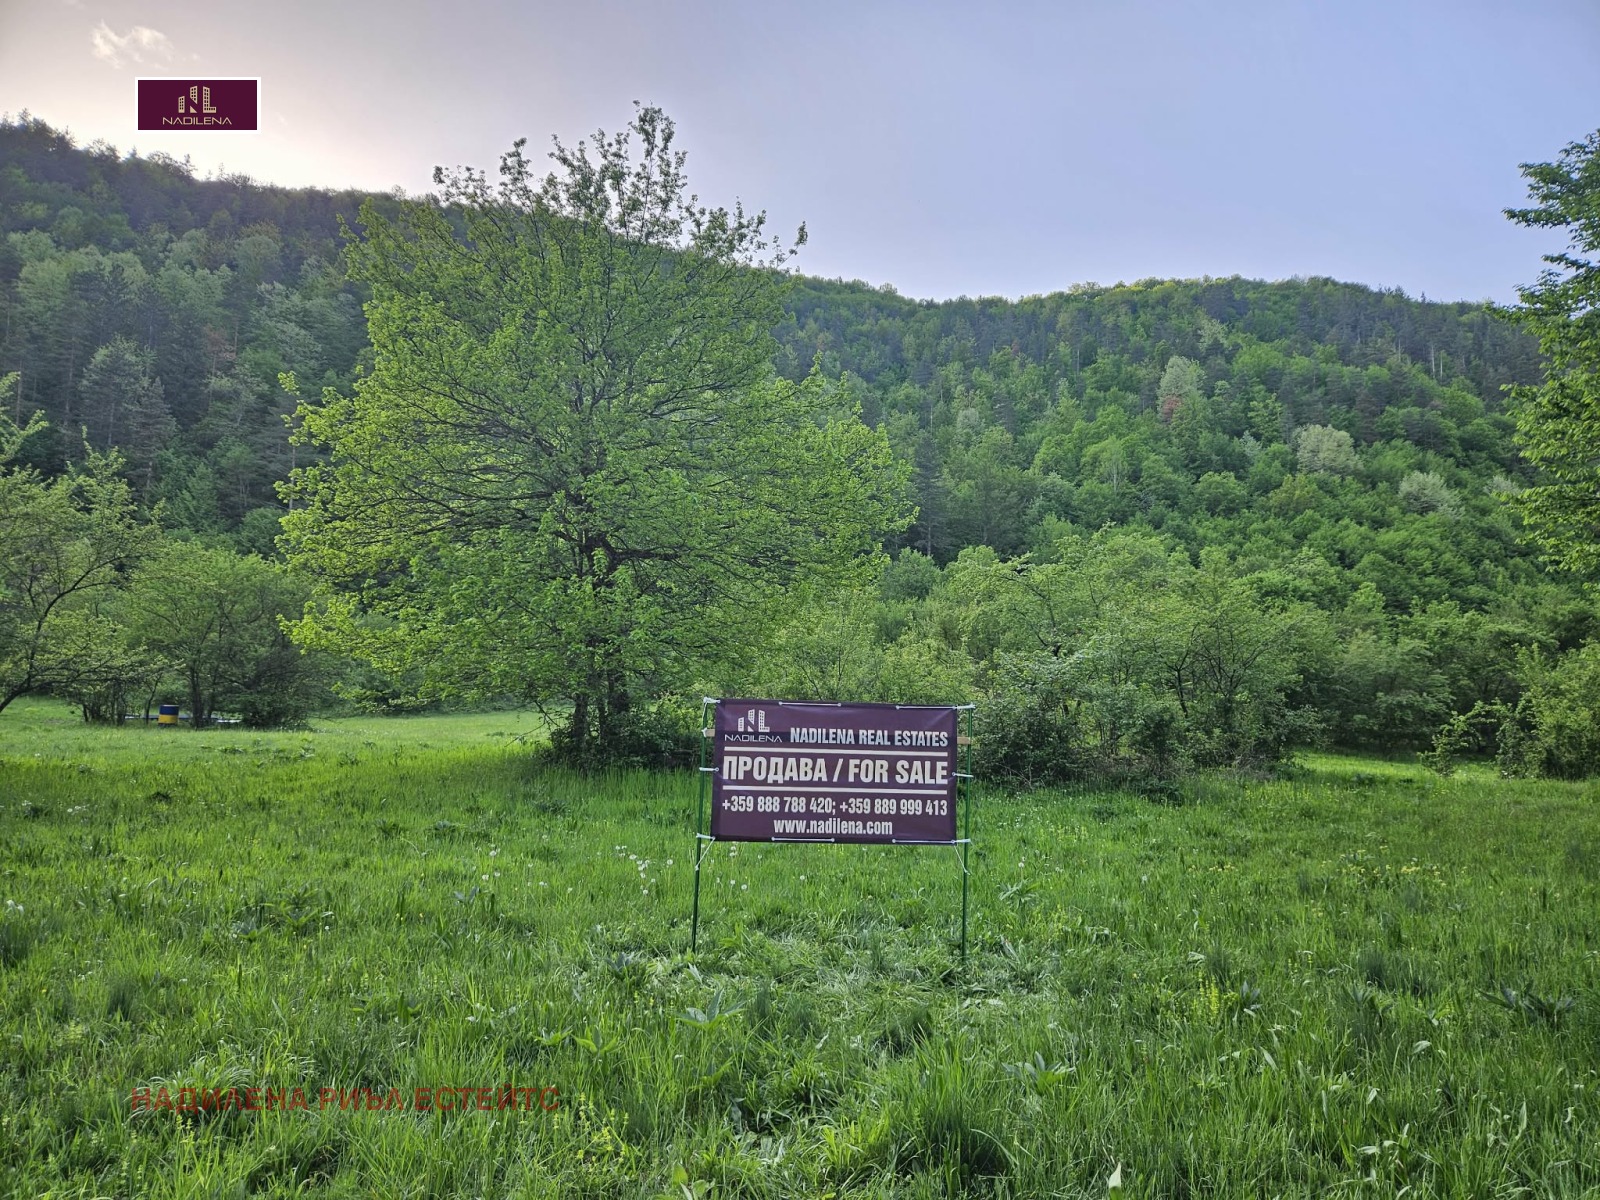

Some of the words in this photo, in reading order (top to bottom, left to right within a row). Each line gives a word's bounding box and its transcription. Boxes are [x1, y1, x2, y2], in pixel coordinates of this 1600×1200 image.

[724, 734, 782, 743] NADILENA
[790, 727, 854, 745] NADILENA
[859, 730, 890, 746] REAL
[894, 731, 948, 747] ESTATES
[723, 756, 828, 784] ПРОДАВА
[848, 759, 889, 783] FOR
[895, 760, 948, 785] SALE
[722, 796, 753, 812] +359
[757, 796, 780, 812] 888
[784, 797, 806, 812] 788
[809, 798, 836, 815] 420;
[840, 798, 871, 814] +359
[874, 799, 896, 814] 889
[900, 800, 922, 815] 999
[925, 800, 948, 816] 413
[774, 818, 892, 835] www.nadilena.com
